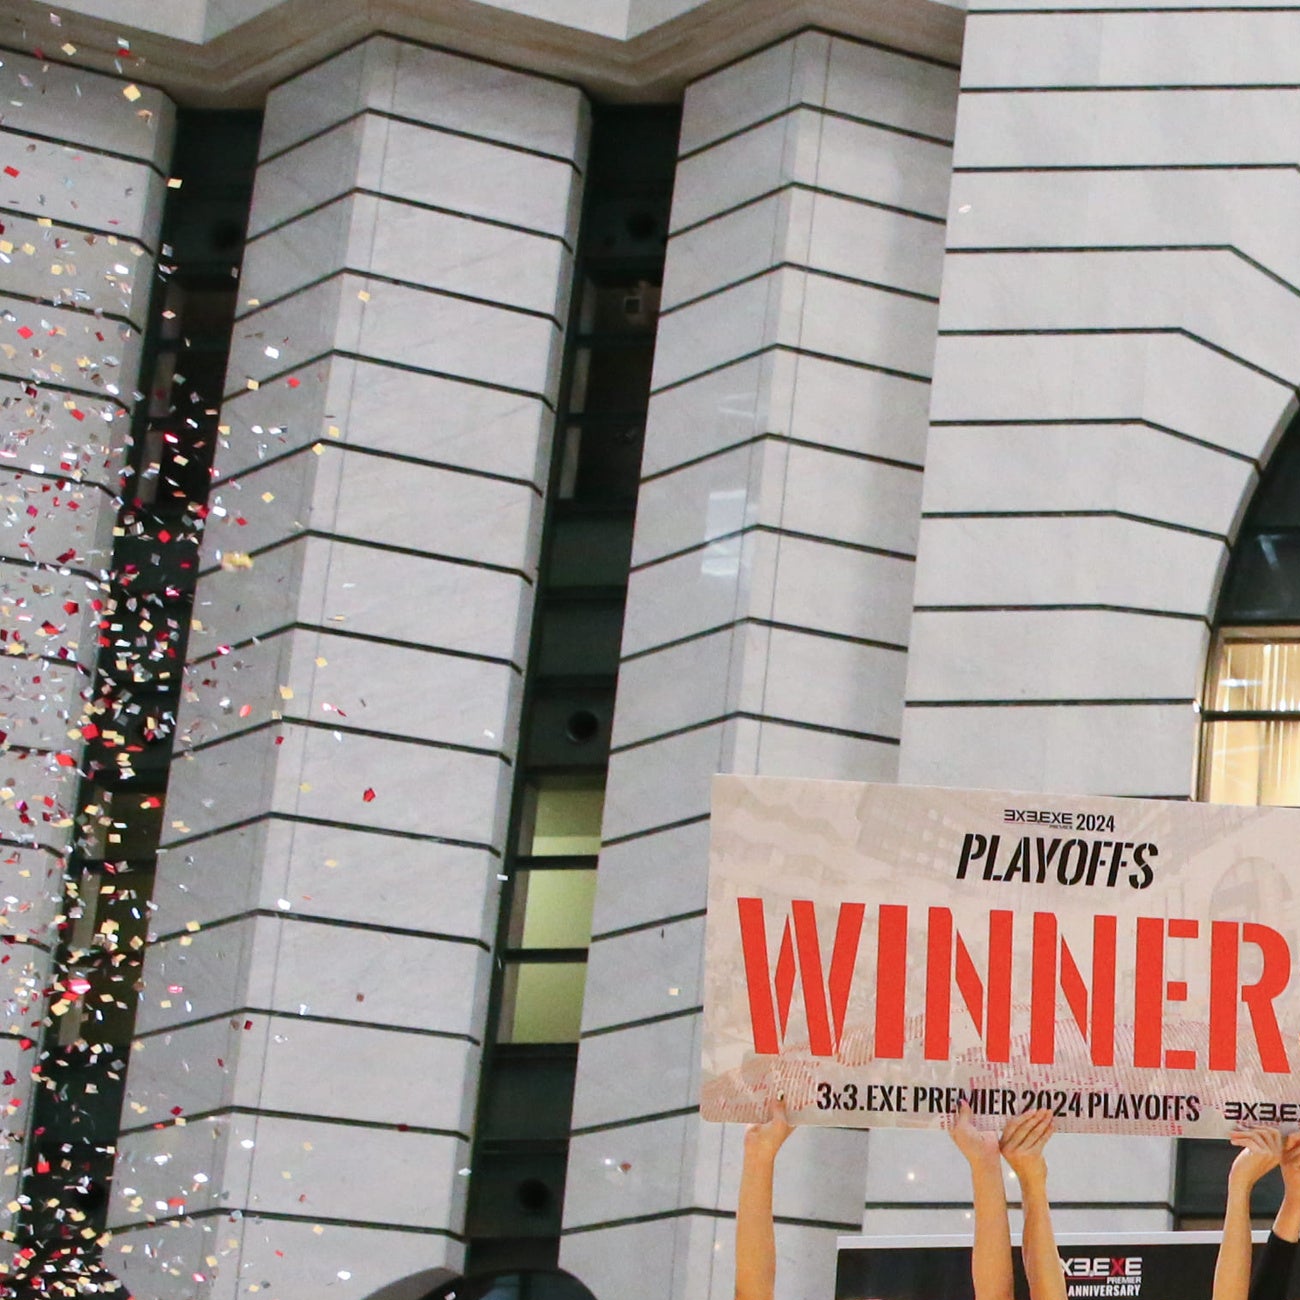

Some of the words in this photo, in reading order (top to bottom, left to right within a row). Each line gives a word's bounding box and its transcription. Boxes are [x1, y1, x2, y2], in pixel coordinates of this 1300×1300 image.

[1076, 814, 1115, 832] 2024
[956, 833, 1159, 889] PLAYOFFS
[913, 1086, 1016, 1116] PREMIER
[1021, 1090, 1083, 1118] 2024
[1087, 1093, 1201, 1122] PLAYOFFS
[1068, 1284, 1140, 1297] ANNIVERSARY
